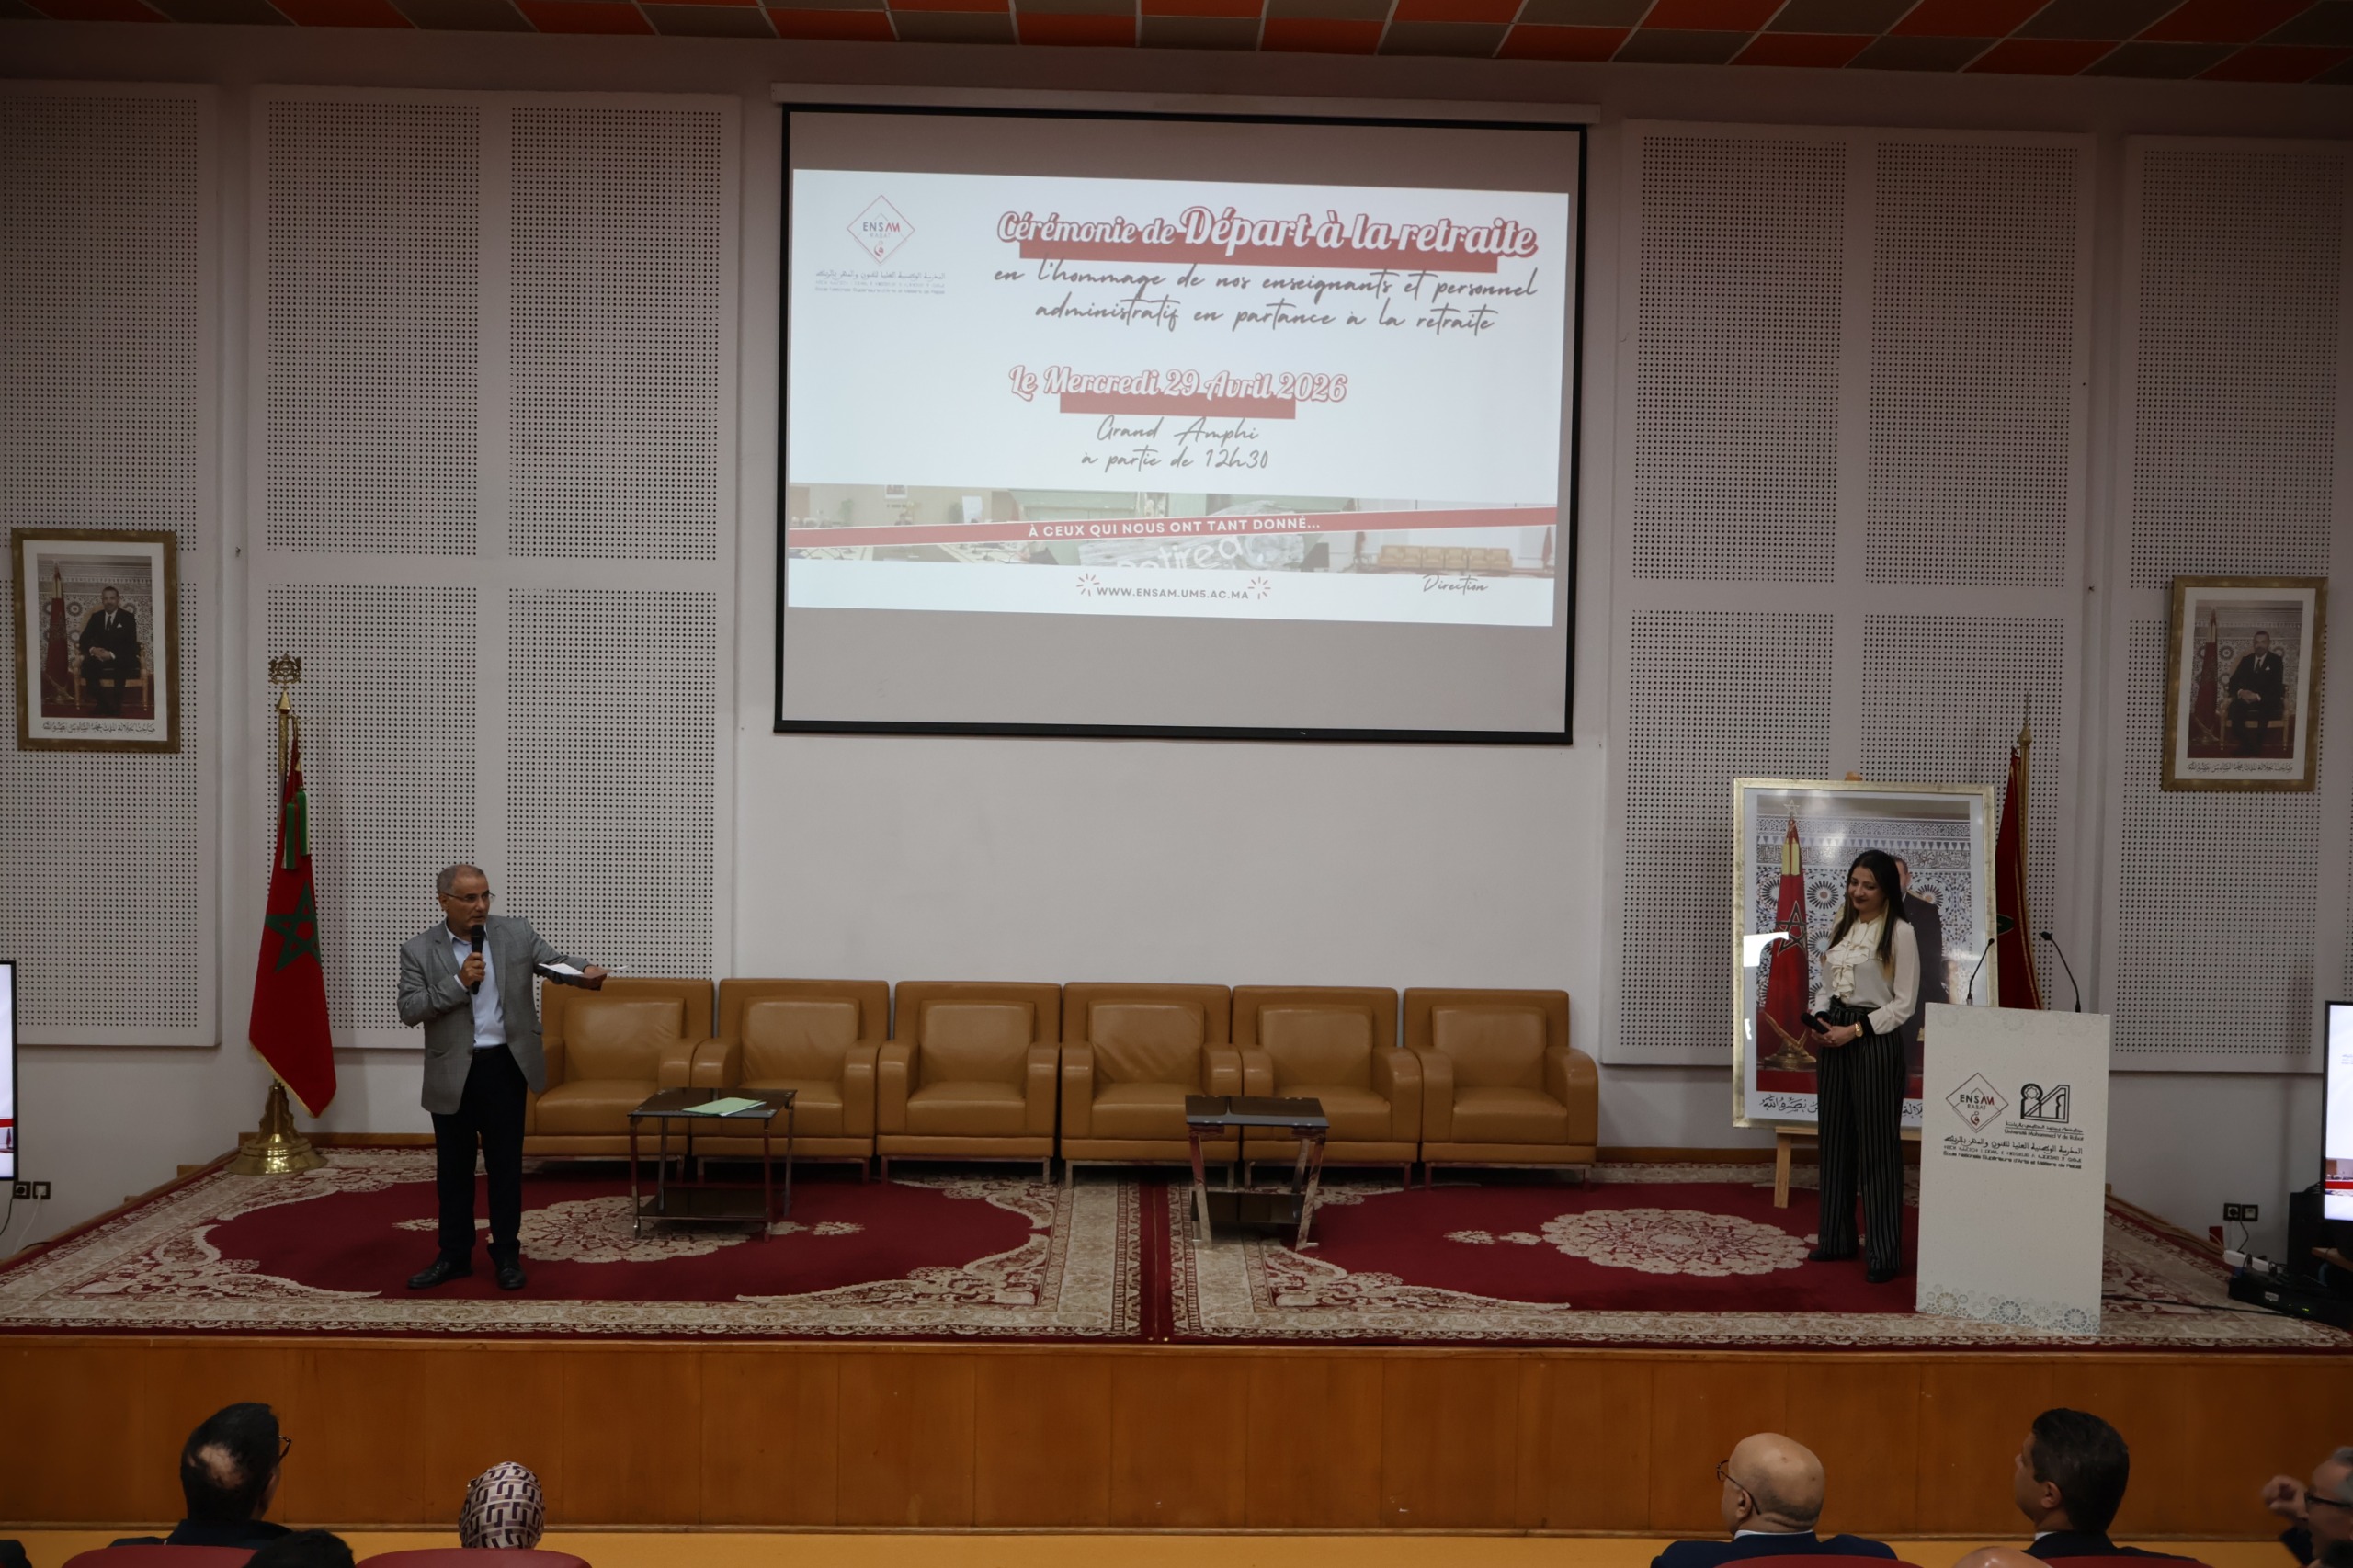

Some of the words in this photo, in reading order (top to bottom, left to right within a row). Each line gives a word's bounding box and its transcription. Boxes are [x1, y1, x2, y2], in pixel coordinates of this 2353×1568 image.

[997, 210, 1140, 244] Cérémonie
[1140, 217, 1176, 244] de
[1178, 205, 1312, 256] Départ
[1316, 210, 1345, 249] à
[1351, 213, 1392, 251] la
[1397, 217, 1540, 258] retraite
[994, 269, 1025, 281] en
[1038, 253, 1167, 298] l'hommage
[1176, 259, 1205, 288] de
[1215, 277, 1251, 290] nos
[1262, 268, 1400, 305] enseignants
[1404, 269, 1438, 301] et
[1432, 267, 1539, 304] personnel
[1035, 290, 1181, 332] administratif
[1193, 310, 1224, 322] en
[1232, 297, 1336, 332] partance
[1347, 311, 1367, 325] à
[1379, 297, 1406, 327] la
[1416, 302, 1499, 336] retraite
[1008, 364, 1040, 403] Le
[1043, 365, 1161, 396] Mercredi
[1162, 369, 1200, 397] 29
[1199, 370, 1272, 402] Avril
[1274, 372, 1349, 403] 2026
[1097, 414, 1165, 441] Grand
[1174, 415, 1259, 446] Amphi
[1081, 450, 1099, 466] à
[1104, 444, 1163, 473] partie
[1169, 445, 1195, 469] de
[1205, 448, 1269, 470] 12h30
[1029, 524, 1040, 537] À
[1042, 525, 1085, 537] CEUX
[1089, 525, 1118, 536] QUI
[1122, 523, 1165, 534] NOUS
[1170, 521, 1202, 533] ONT
[1206, 519, 1247, 532] TANT
[1253, 515, 1321, 531] DONNÉ...
[1097, 587, 1249, 600] WWW.ENSAM.UM5.AC.MA
[1422, 573, 1489, 596] Direction
